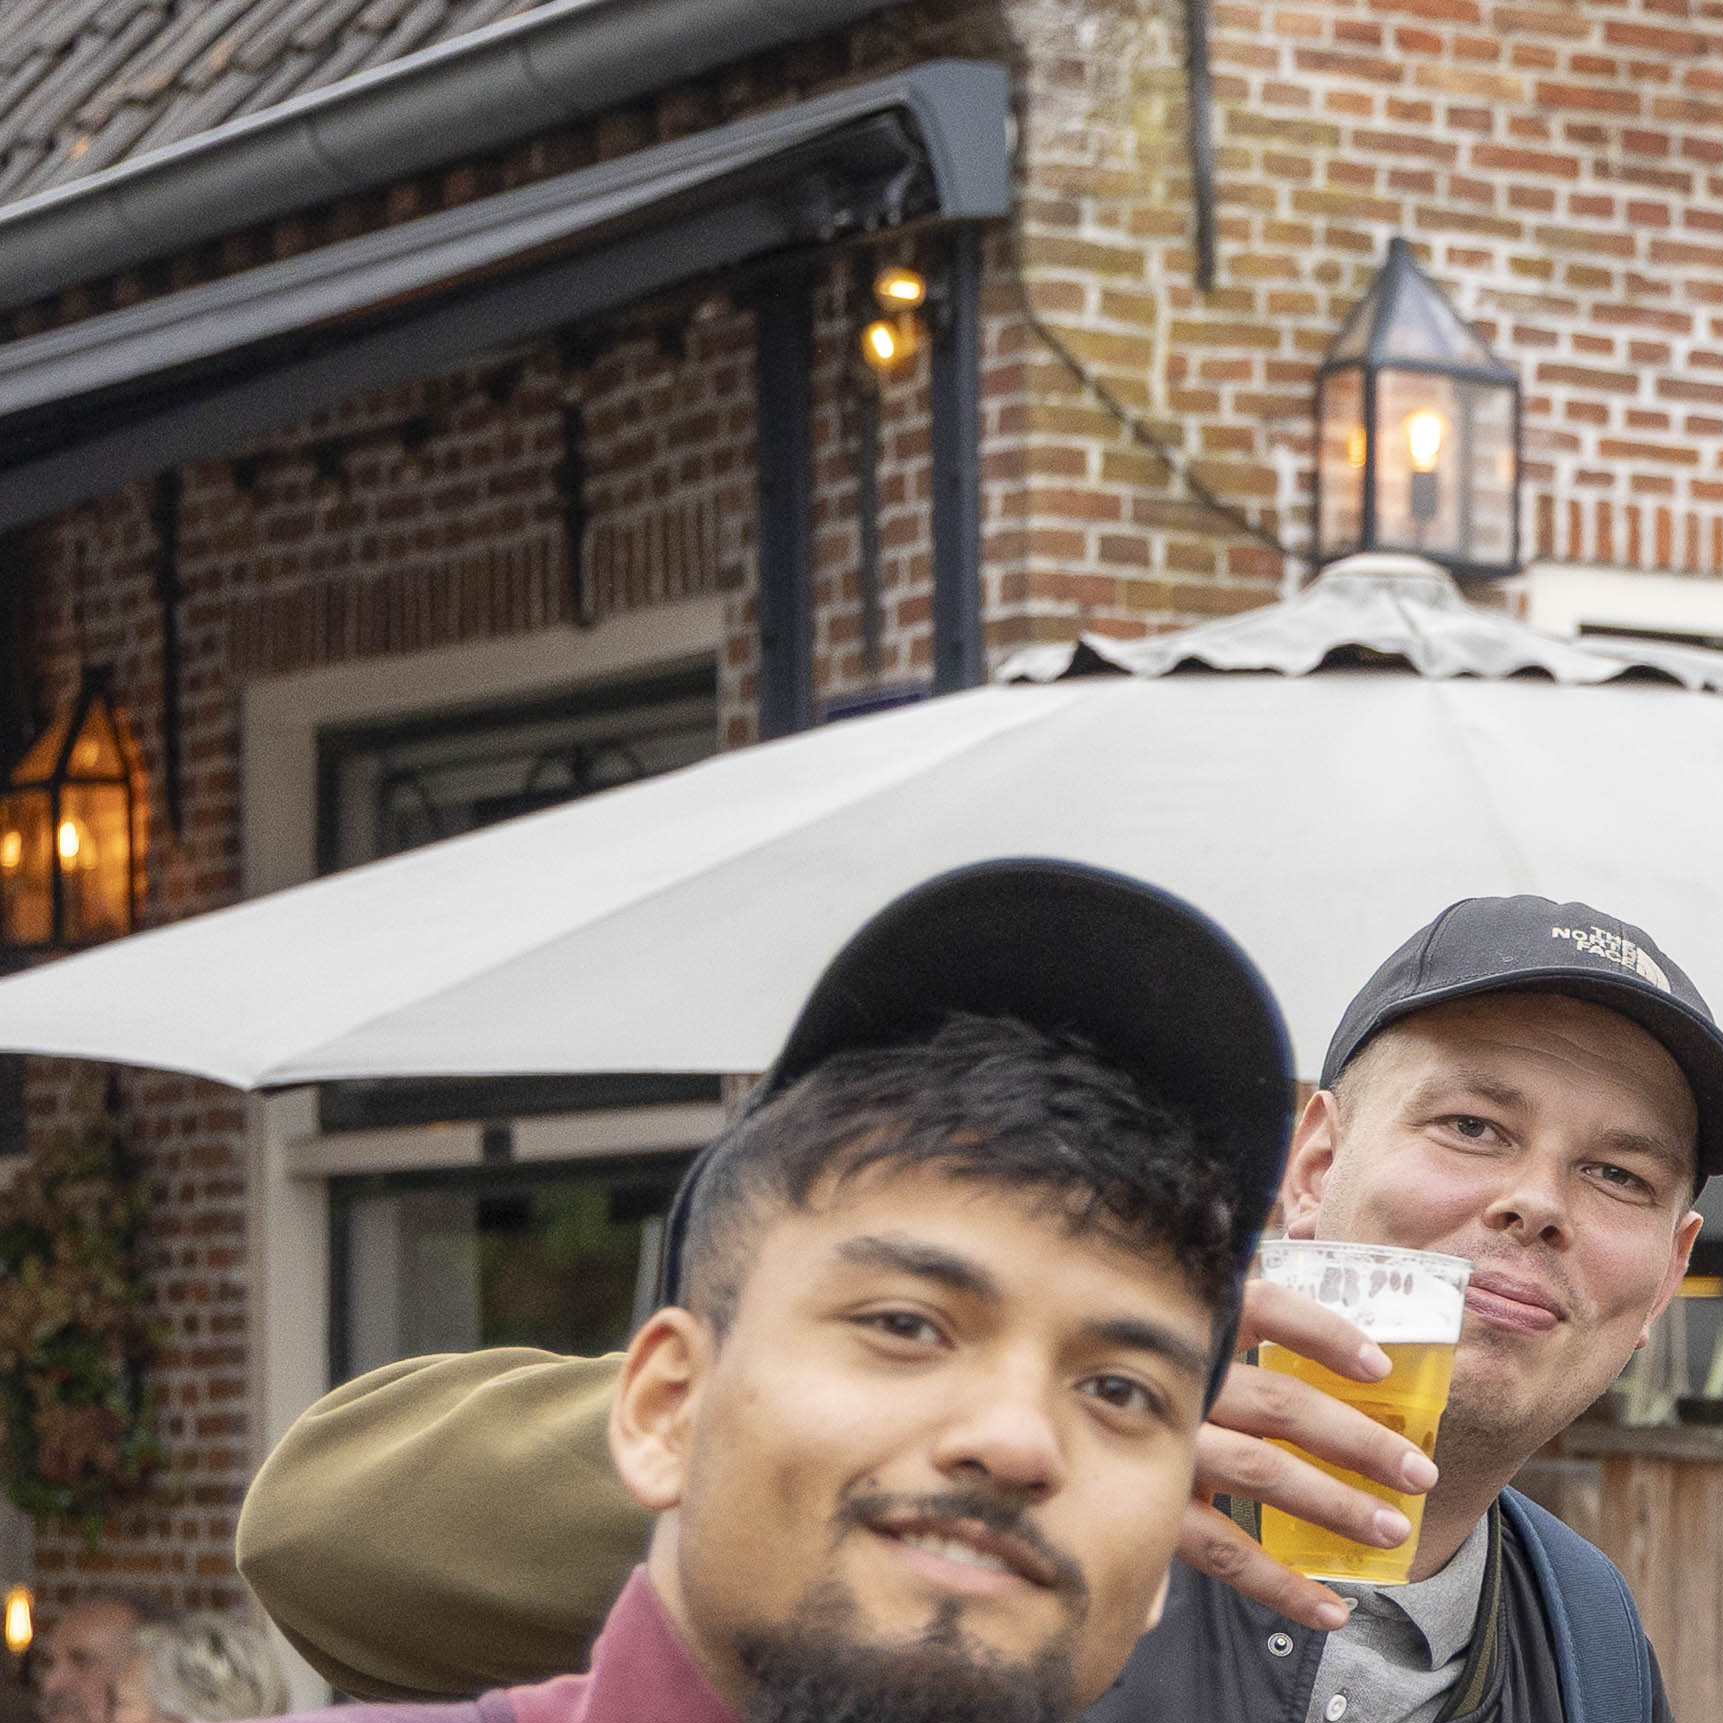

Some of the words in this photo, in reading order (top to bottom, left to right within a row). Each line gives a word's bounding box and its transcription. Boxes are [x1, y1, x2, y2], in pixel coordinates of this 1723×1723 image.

[1552, 927, 1636, 959] NORTH
[1591, 926, 1636, 949] THE
[1576, 941, 1636, 971] FACE
